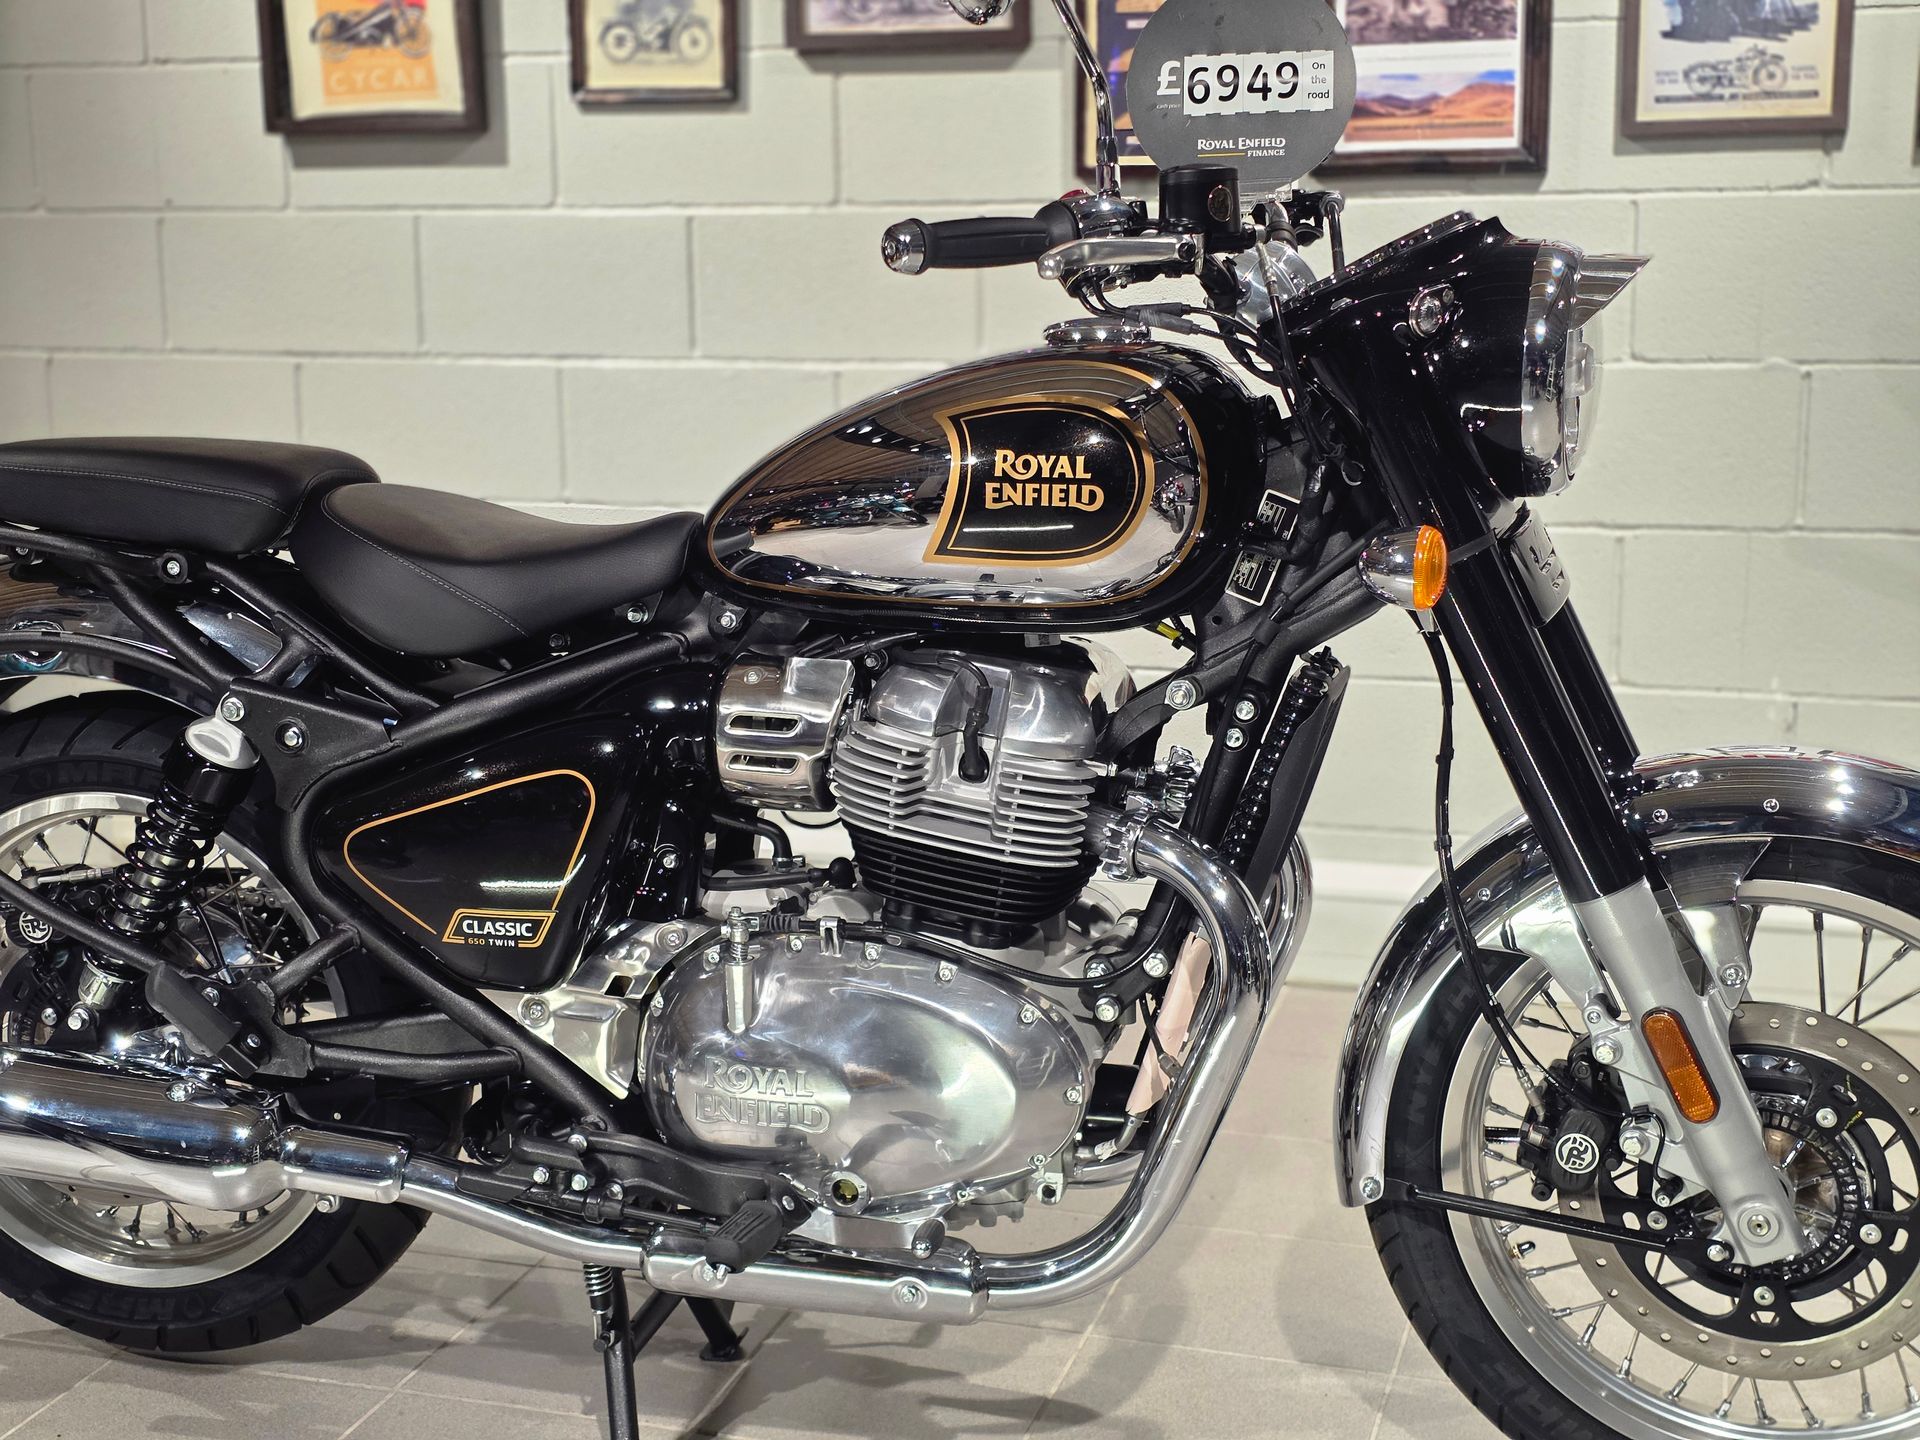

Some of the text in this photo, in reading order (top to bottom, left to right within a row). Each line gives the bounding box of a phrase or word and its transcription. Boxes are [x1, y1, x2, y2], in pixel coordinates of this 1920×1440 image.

[1311, 61, 1326, 70] On
[1311, 74, 1327, 84] the
[1307, 89, 1330, 100] road
[1197, 137, 1286, 151] ROYAL ENFIELD
[1247, 149, 1286, 157] FINANCE
[994, 449, 1092, 481] ROYAL
[984, 482, 1105, 512] ENFIELD
[462, 919, 533, 937] CLASSIC
[467, 937, 515, 947] 650 TWIN
[704, 1055, 815, 1098] ROYAL
[694, 1092, 831, 1134] ENFIELD
